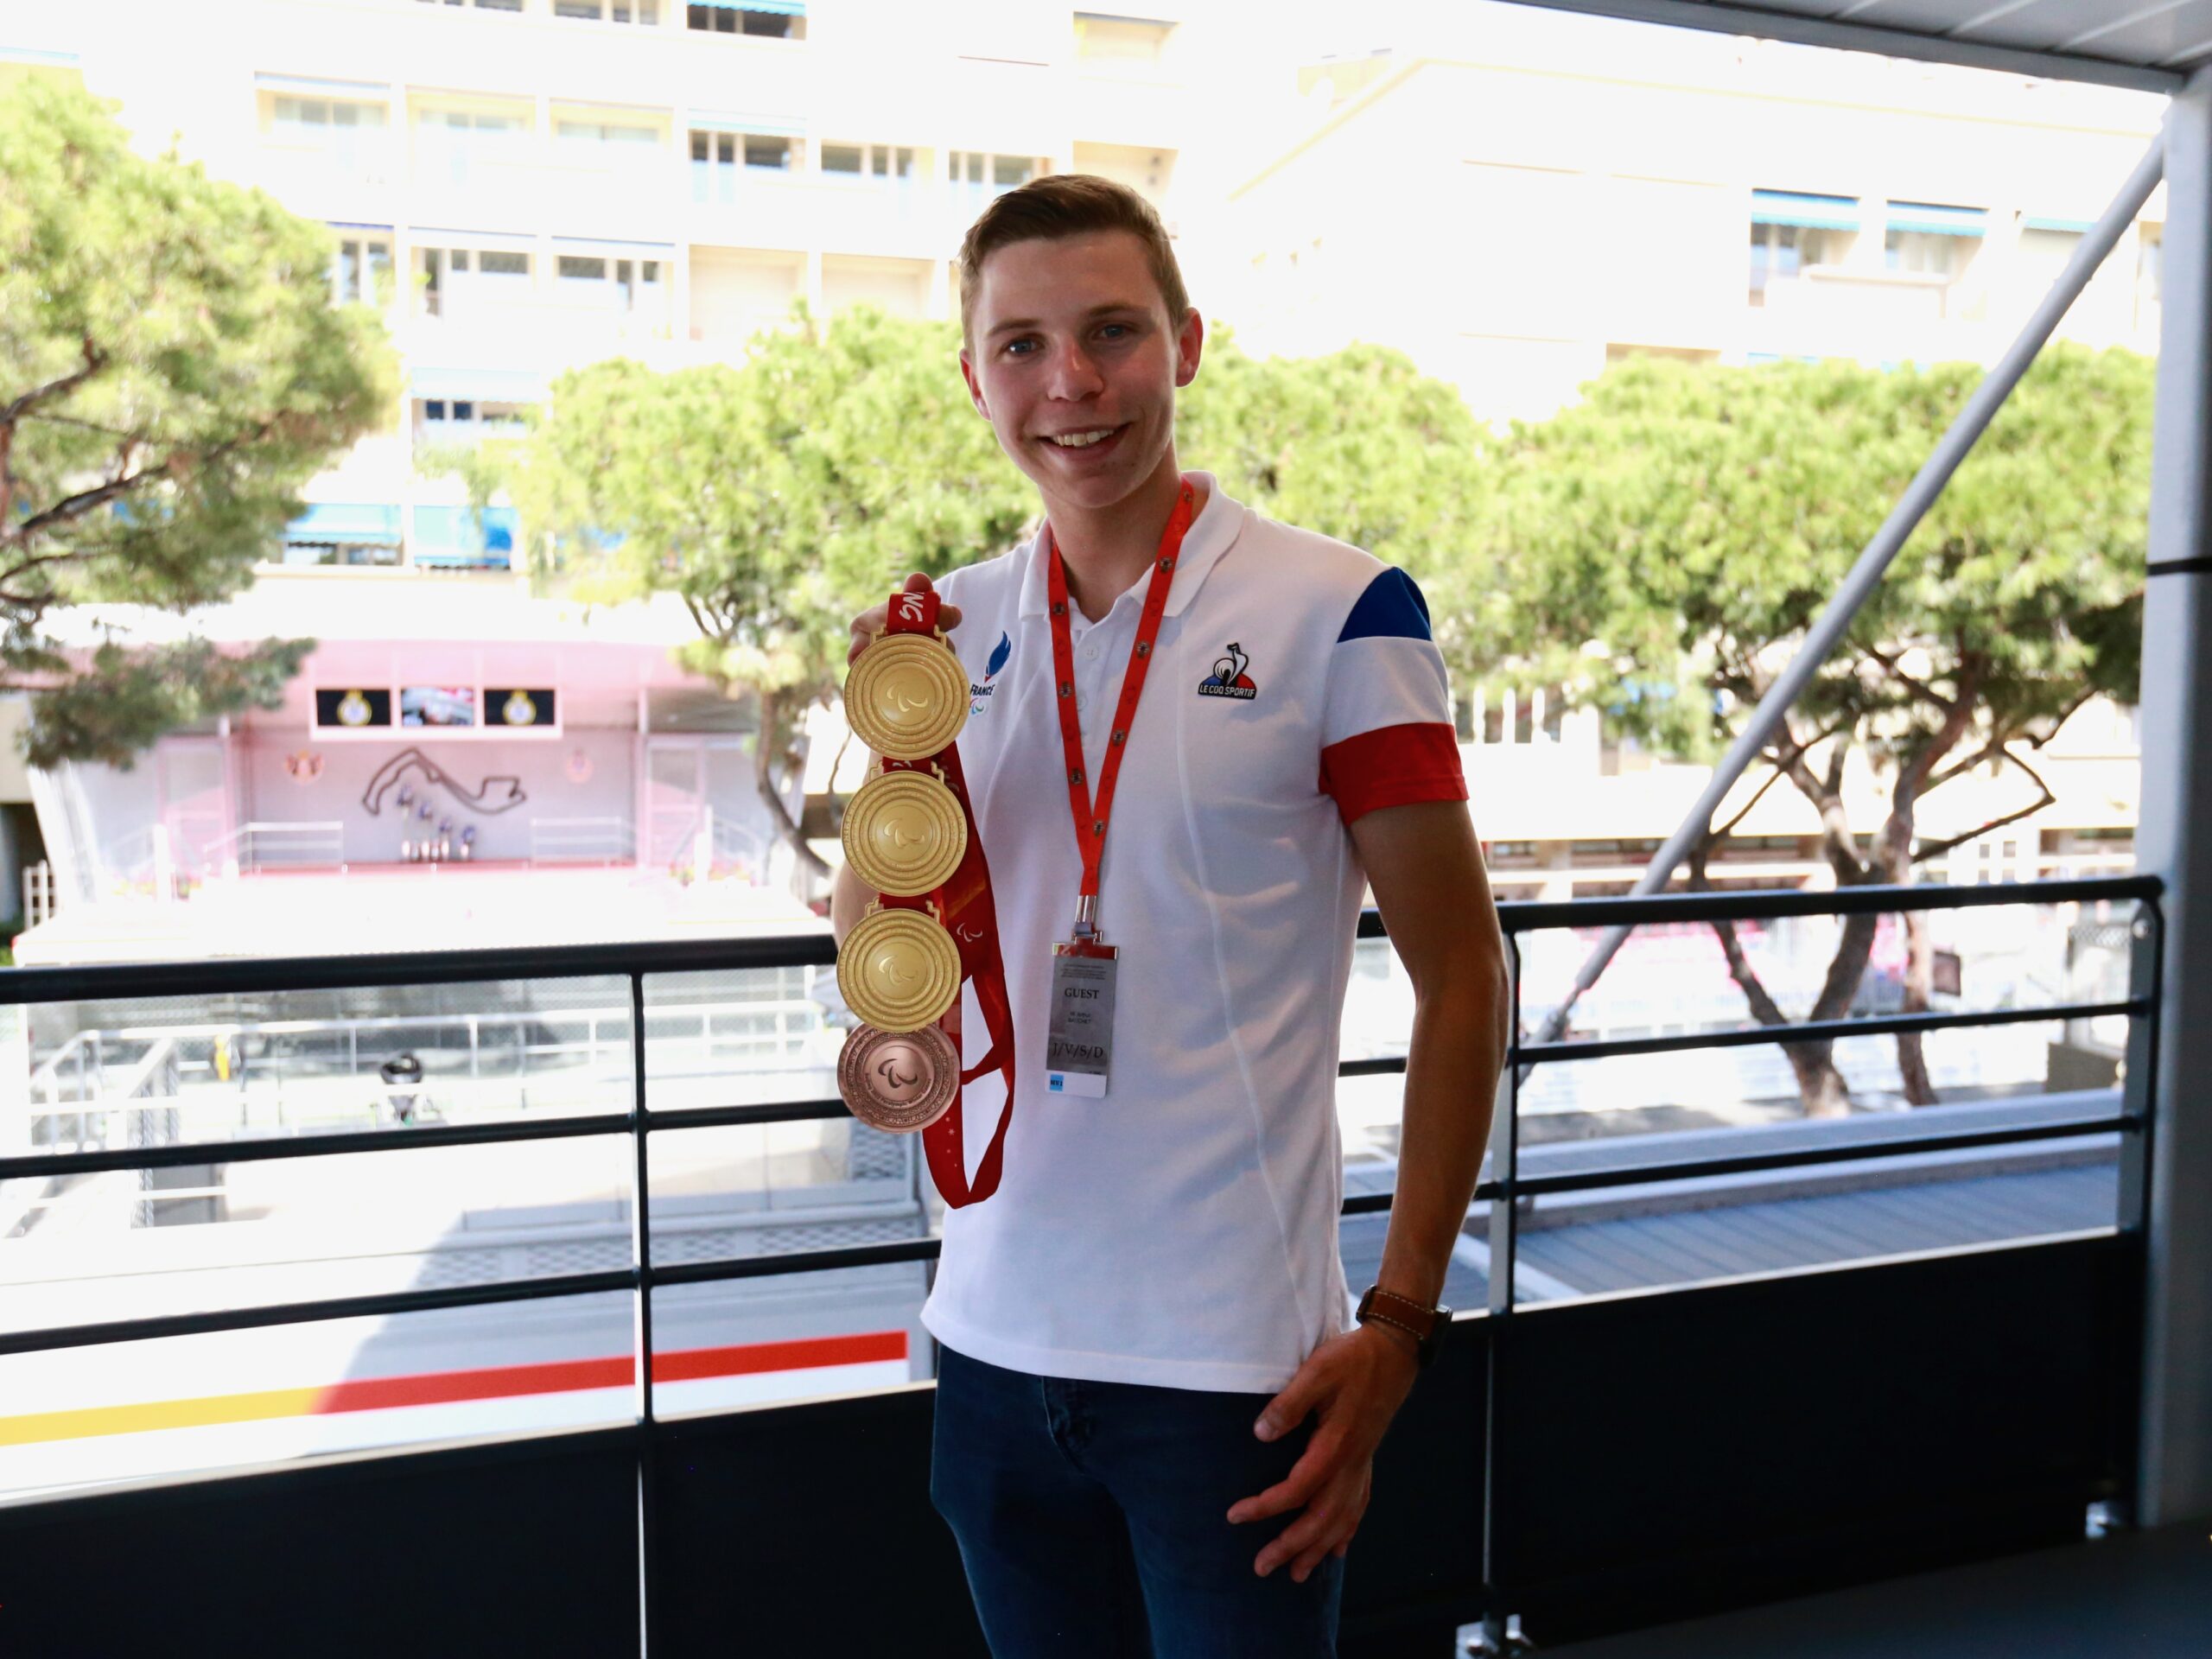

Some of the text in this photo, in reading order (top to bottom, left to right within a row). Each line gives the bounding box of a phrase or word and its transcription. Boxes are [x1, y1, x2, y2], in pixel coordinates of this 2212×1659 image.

[899, 592, 925, 622] NG
[969, 683, 995, 696] FRANCE
[1199, 684, 1255, 697] LE COQ SPORTIF
[1064, 988, 1099, 999] GUEST
